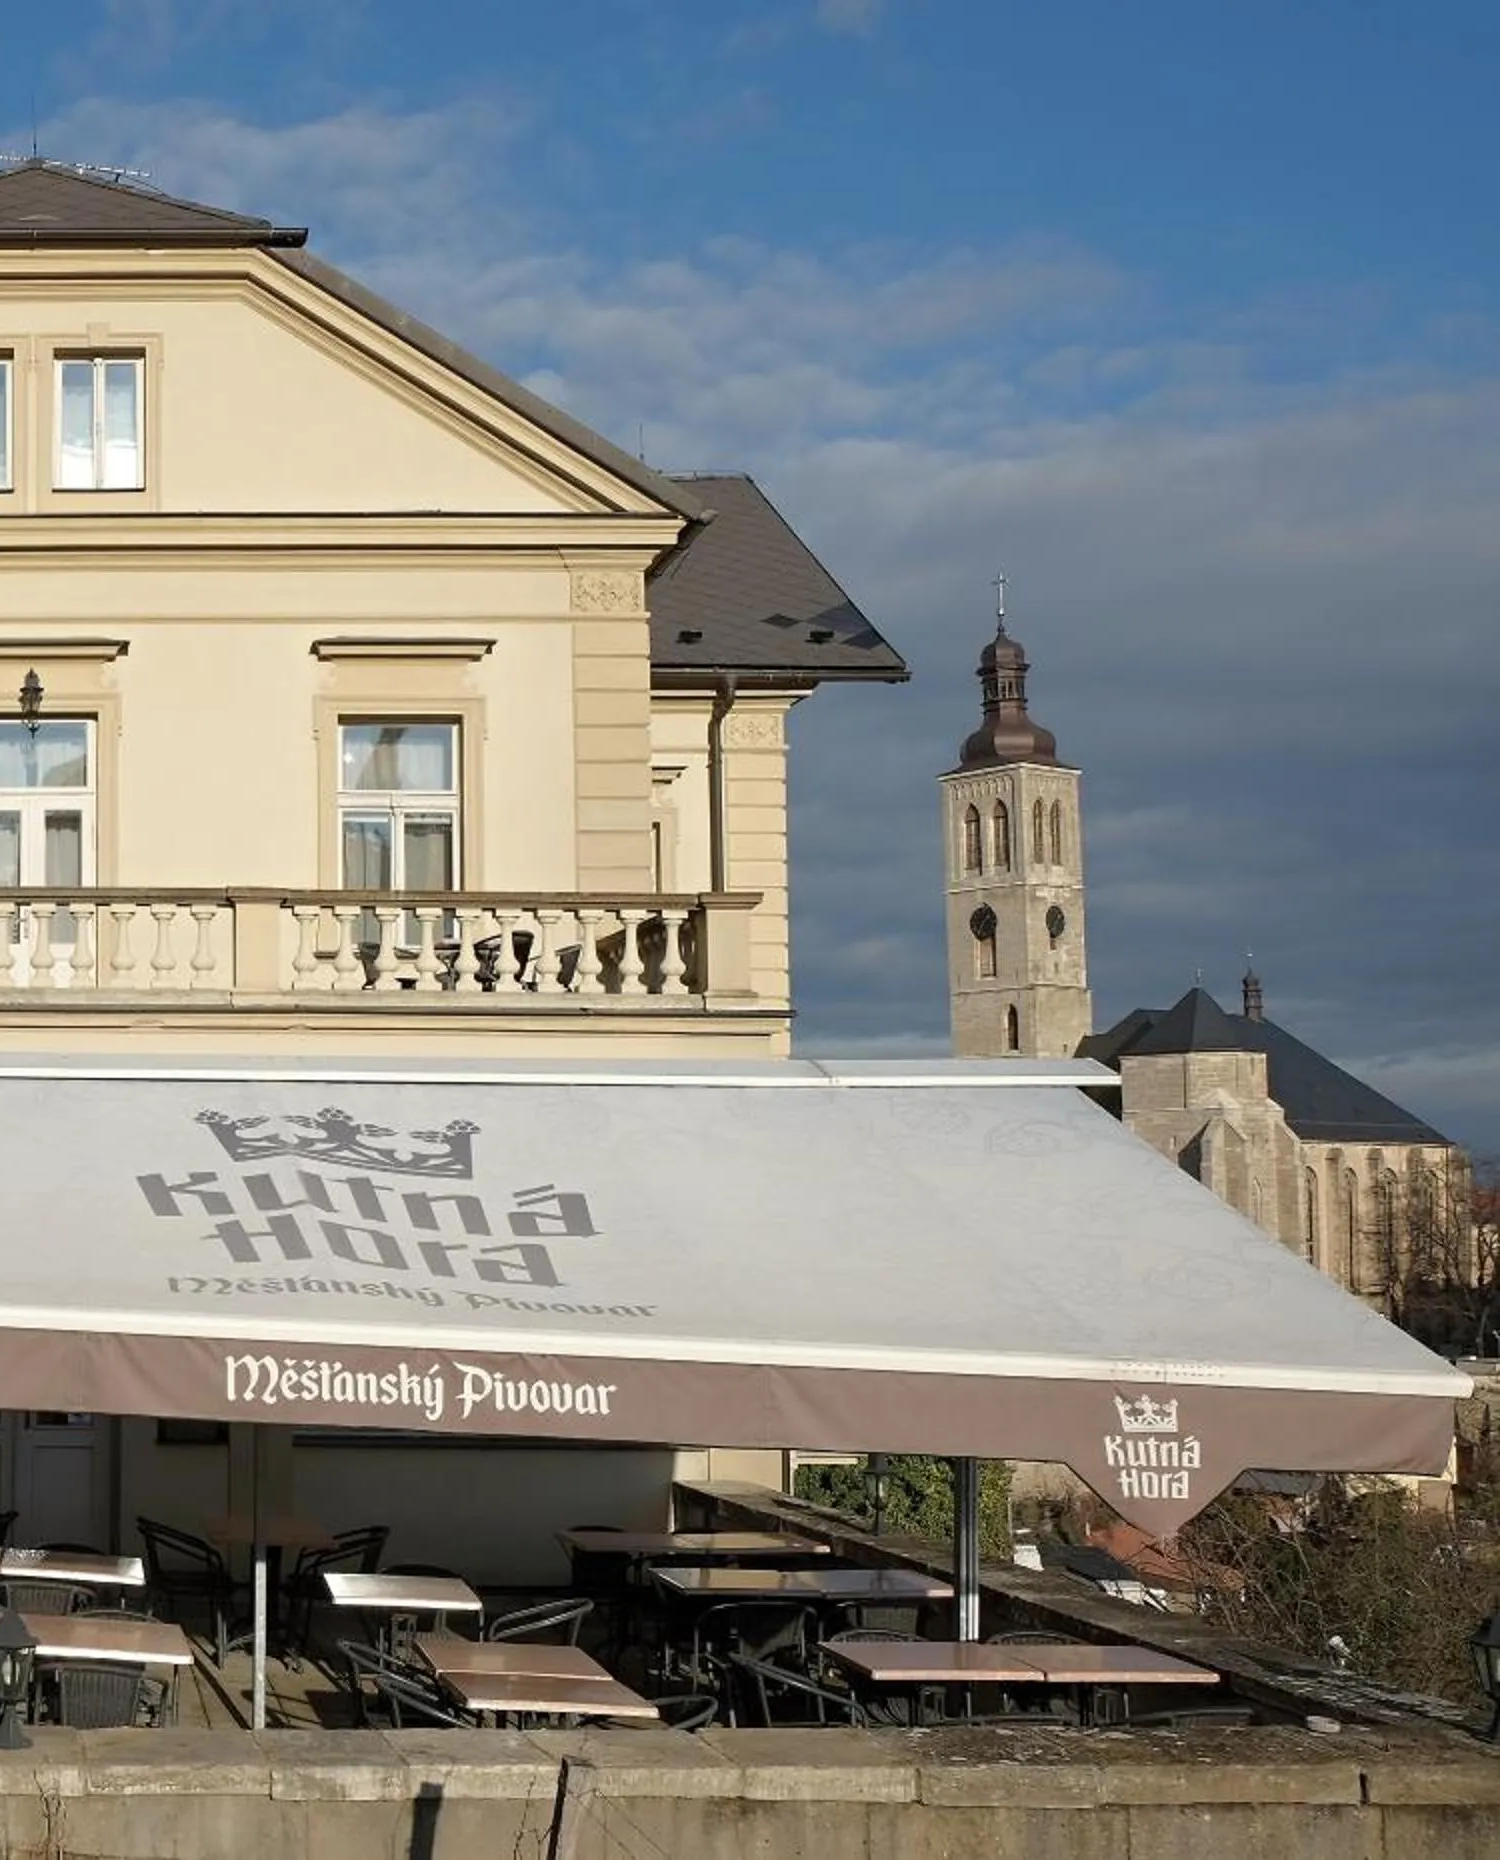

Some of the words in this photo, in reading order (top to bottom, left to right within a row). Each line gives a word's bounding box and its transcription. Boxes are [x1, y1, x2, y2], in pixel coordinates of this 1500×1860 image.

[136, 1170, 604, 1237] Kutná
[202, 1214, 567, 1287] Hora
[451, 1290, 658, 1317] Pivovar
[224, 1354, 444, 1421] Měšťanský
[452, 1360, 618, 1419] Pivovar
[1103, 1434, 1201, 1469] Kutná
[1117, 1468, 1190, 1500] Hora
